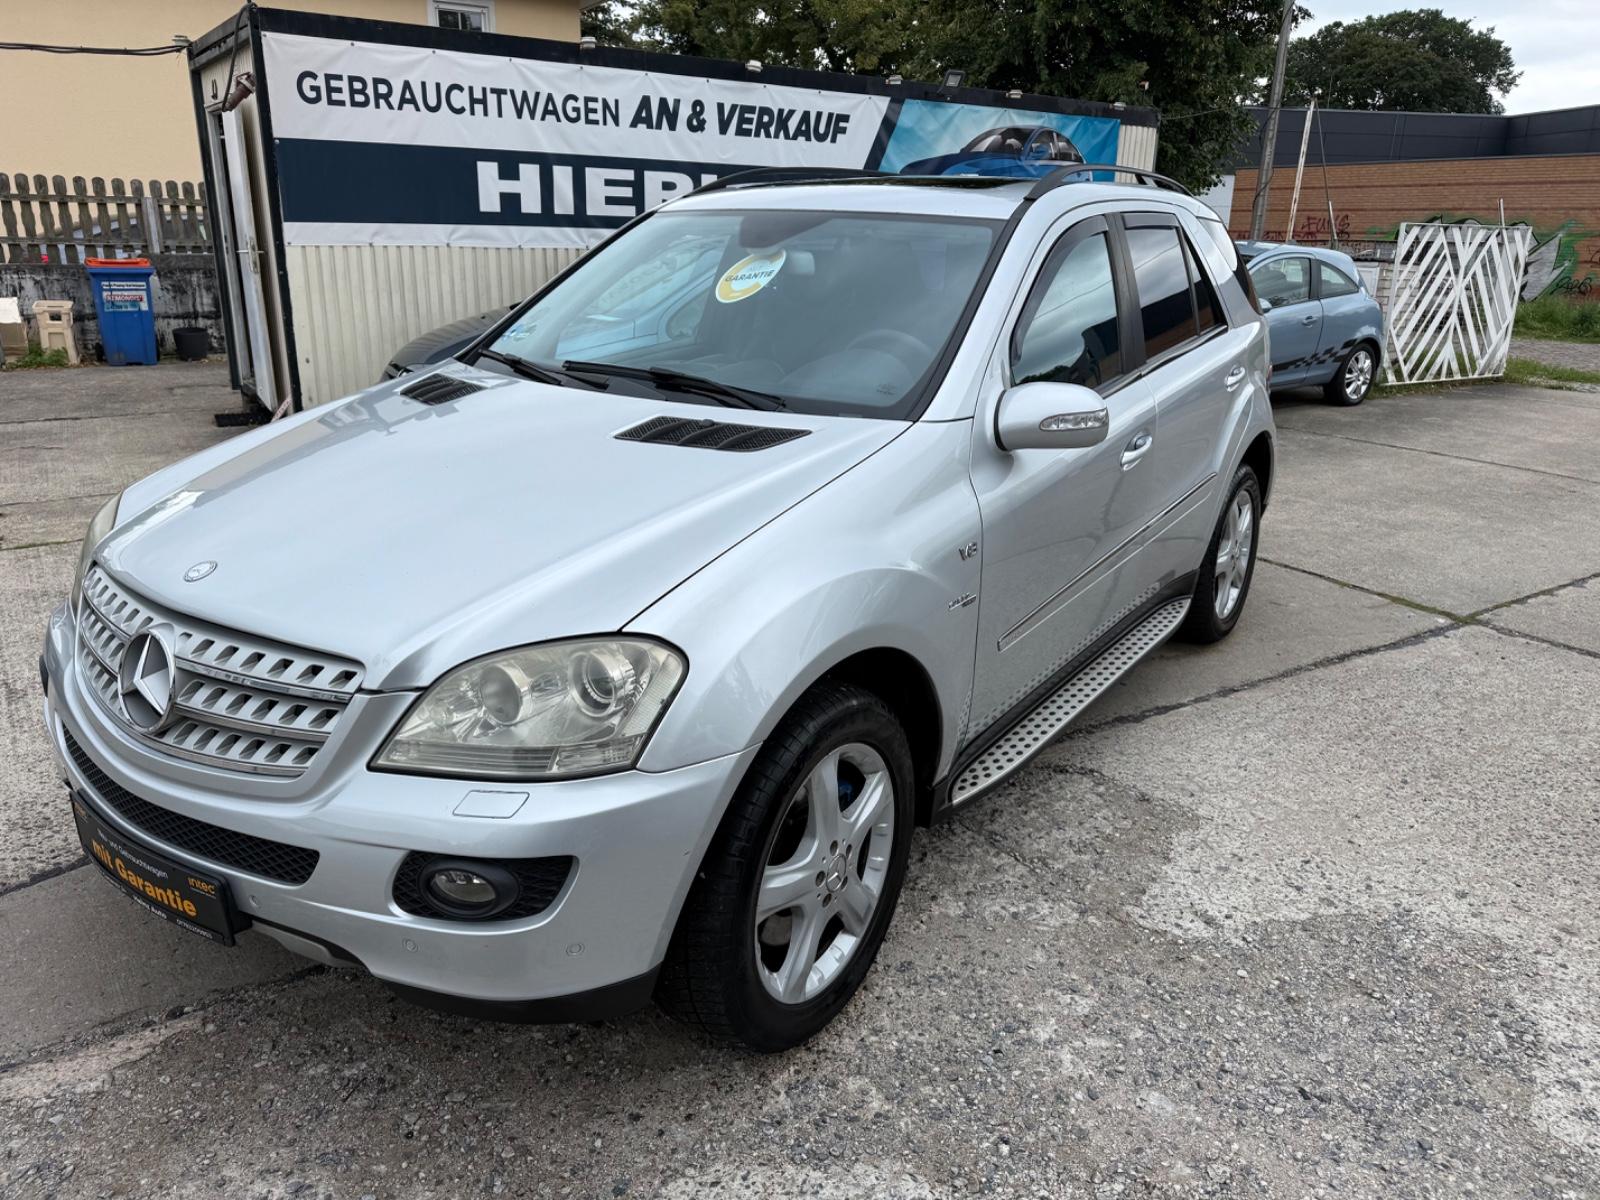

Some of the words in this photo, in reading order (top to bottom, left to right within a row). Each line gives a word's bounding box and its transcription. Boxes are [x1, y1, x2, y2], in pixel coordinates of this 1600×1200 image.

[296, 70, 620, 128] GEBRAUCHTWAGEN
[629, 94, 681, 132] AN
[686, 98, 707, 133] &
[716, 101, 851, 144] VERKAUF
[725, 269, 776, 282] GARANTIE
[92, 839, 114, 870] mit
[115, 857, 198, 918] Garantie
